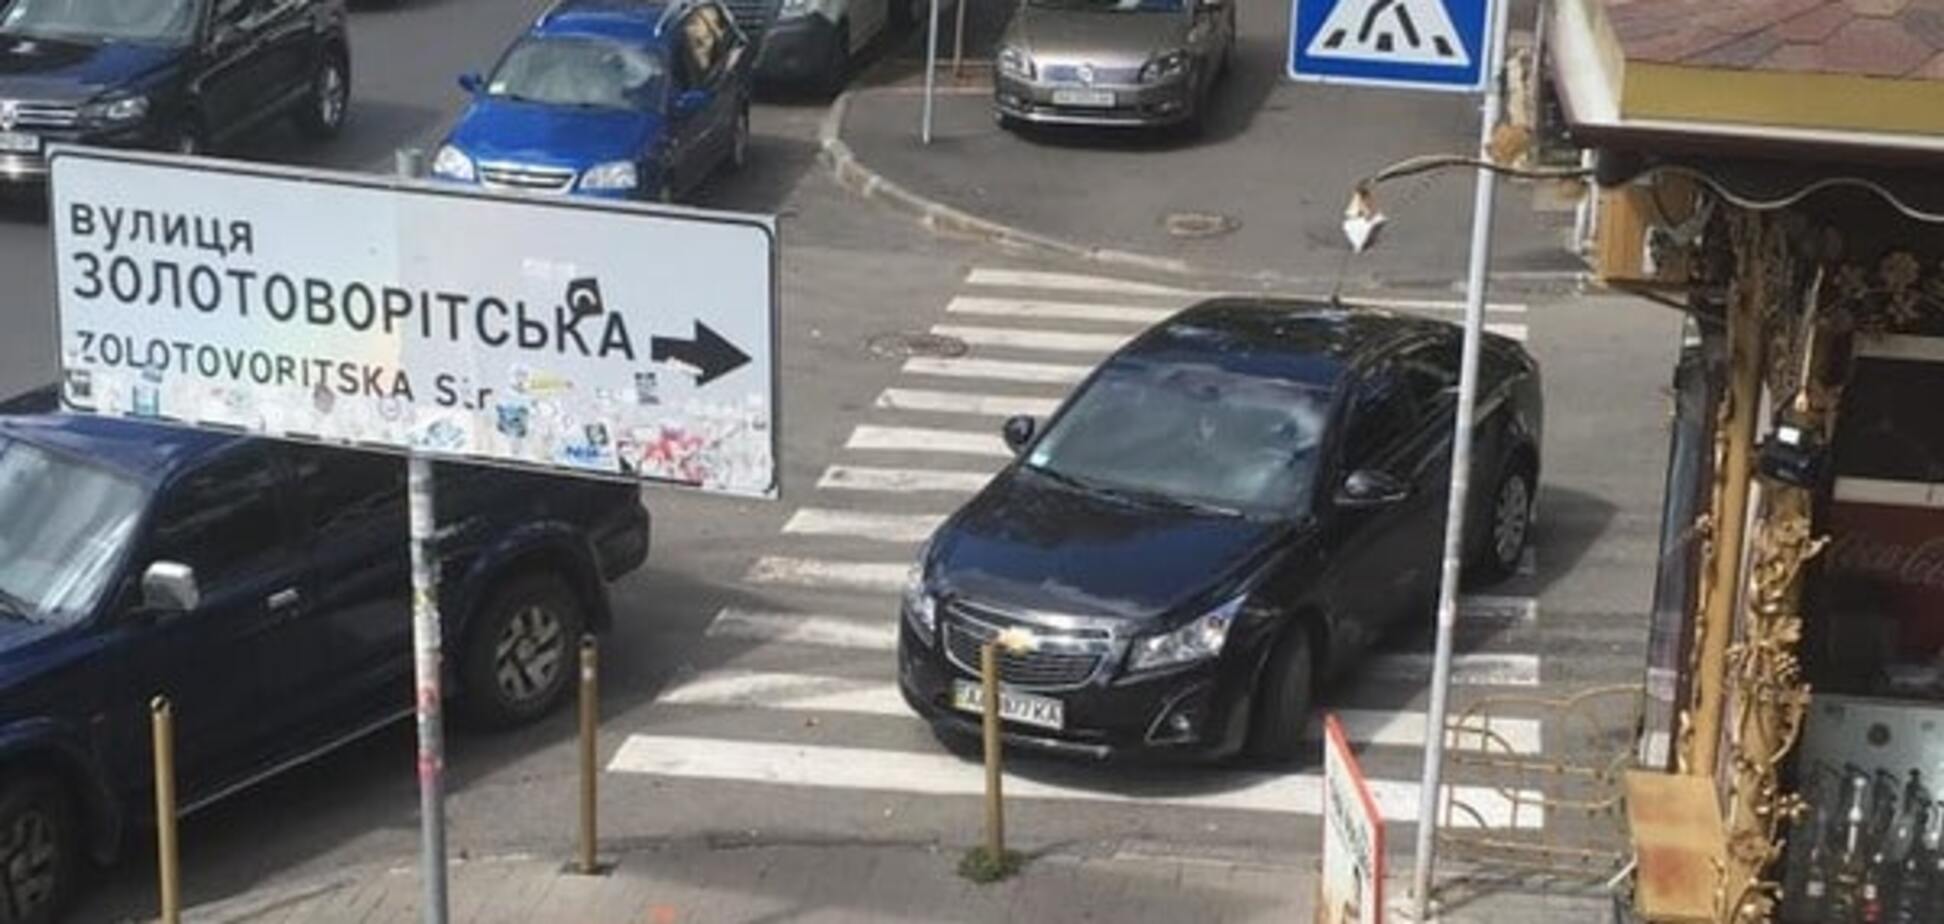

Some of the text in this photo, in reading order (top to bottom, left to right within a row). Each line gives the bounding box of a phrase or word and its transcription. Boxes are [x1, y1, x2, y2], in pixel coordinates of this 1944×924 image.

[70, 203, 254, 258] вулиця
[72, 251, 635, 362] ЗОЛОТОВОРІТСЬКА
[76, 329, 414, 402] ZOLOTOVORITSKA
